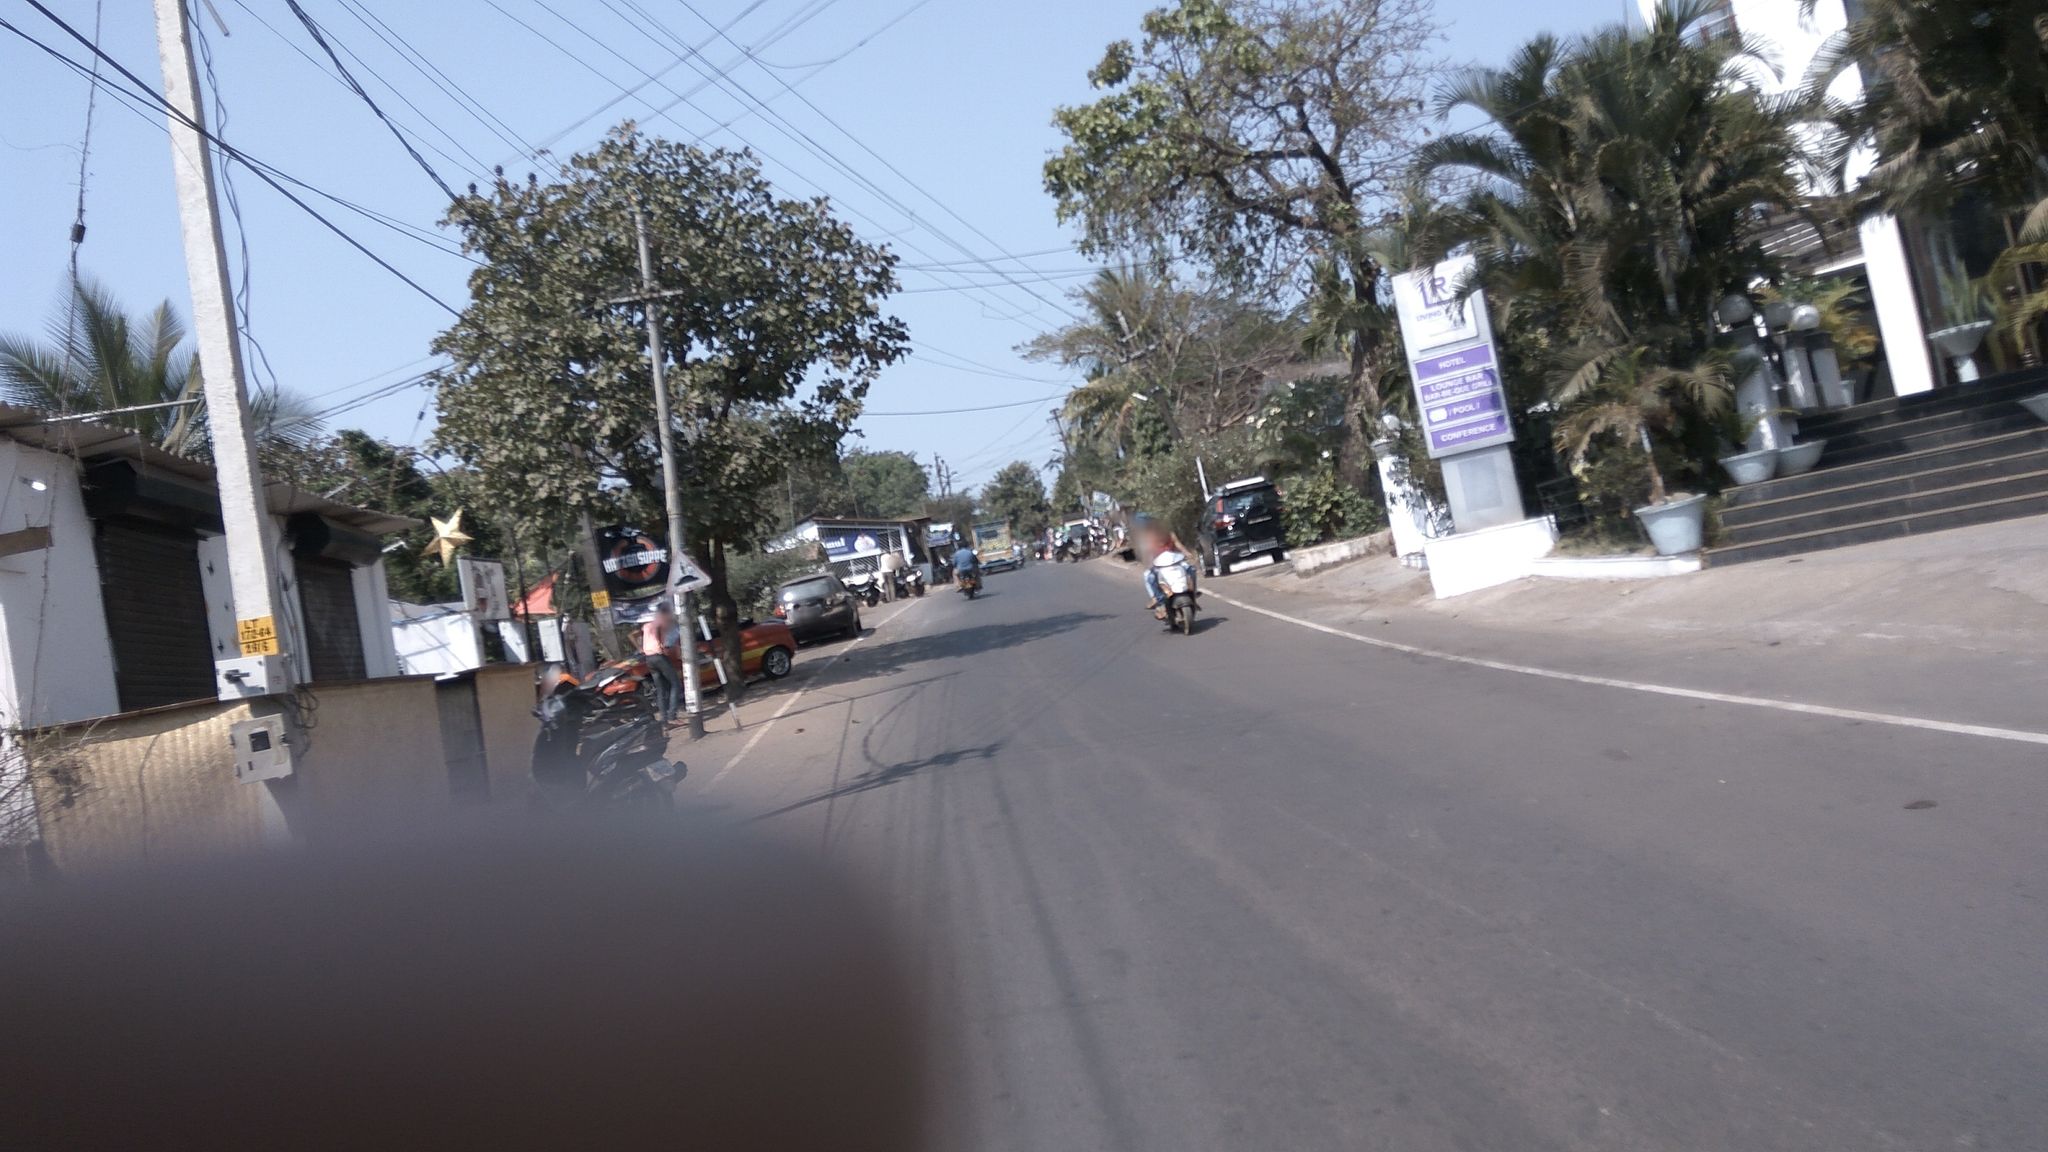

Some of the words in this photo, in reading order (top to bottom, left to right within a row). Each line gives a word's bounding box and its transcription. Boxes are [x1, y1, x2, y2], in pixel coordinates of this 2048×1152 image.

[1438, 357, 1466, 369] HOTEL
[1430, 378, 1463, 391] LOUNGE
[1464, 372, 1484, 383] BAR
[1453, 404, 1475, 415] POOL
[1440, 423, 1497, 442] CONFERENCE
